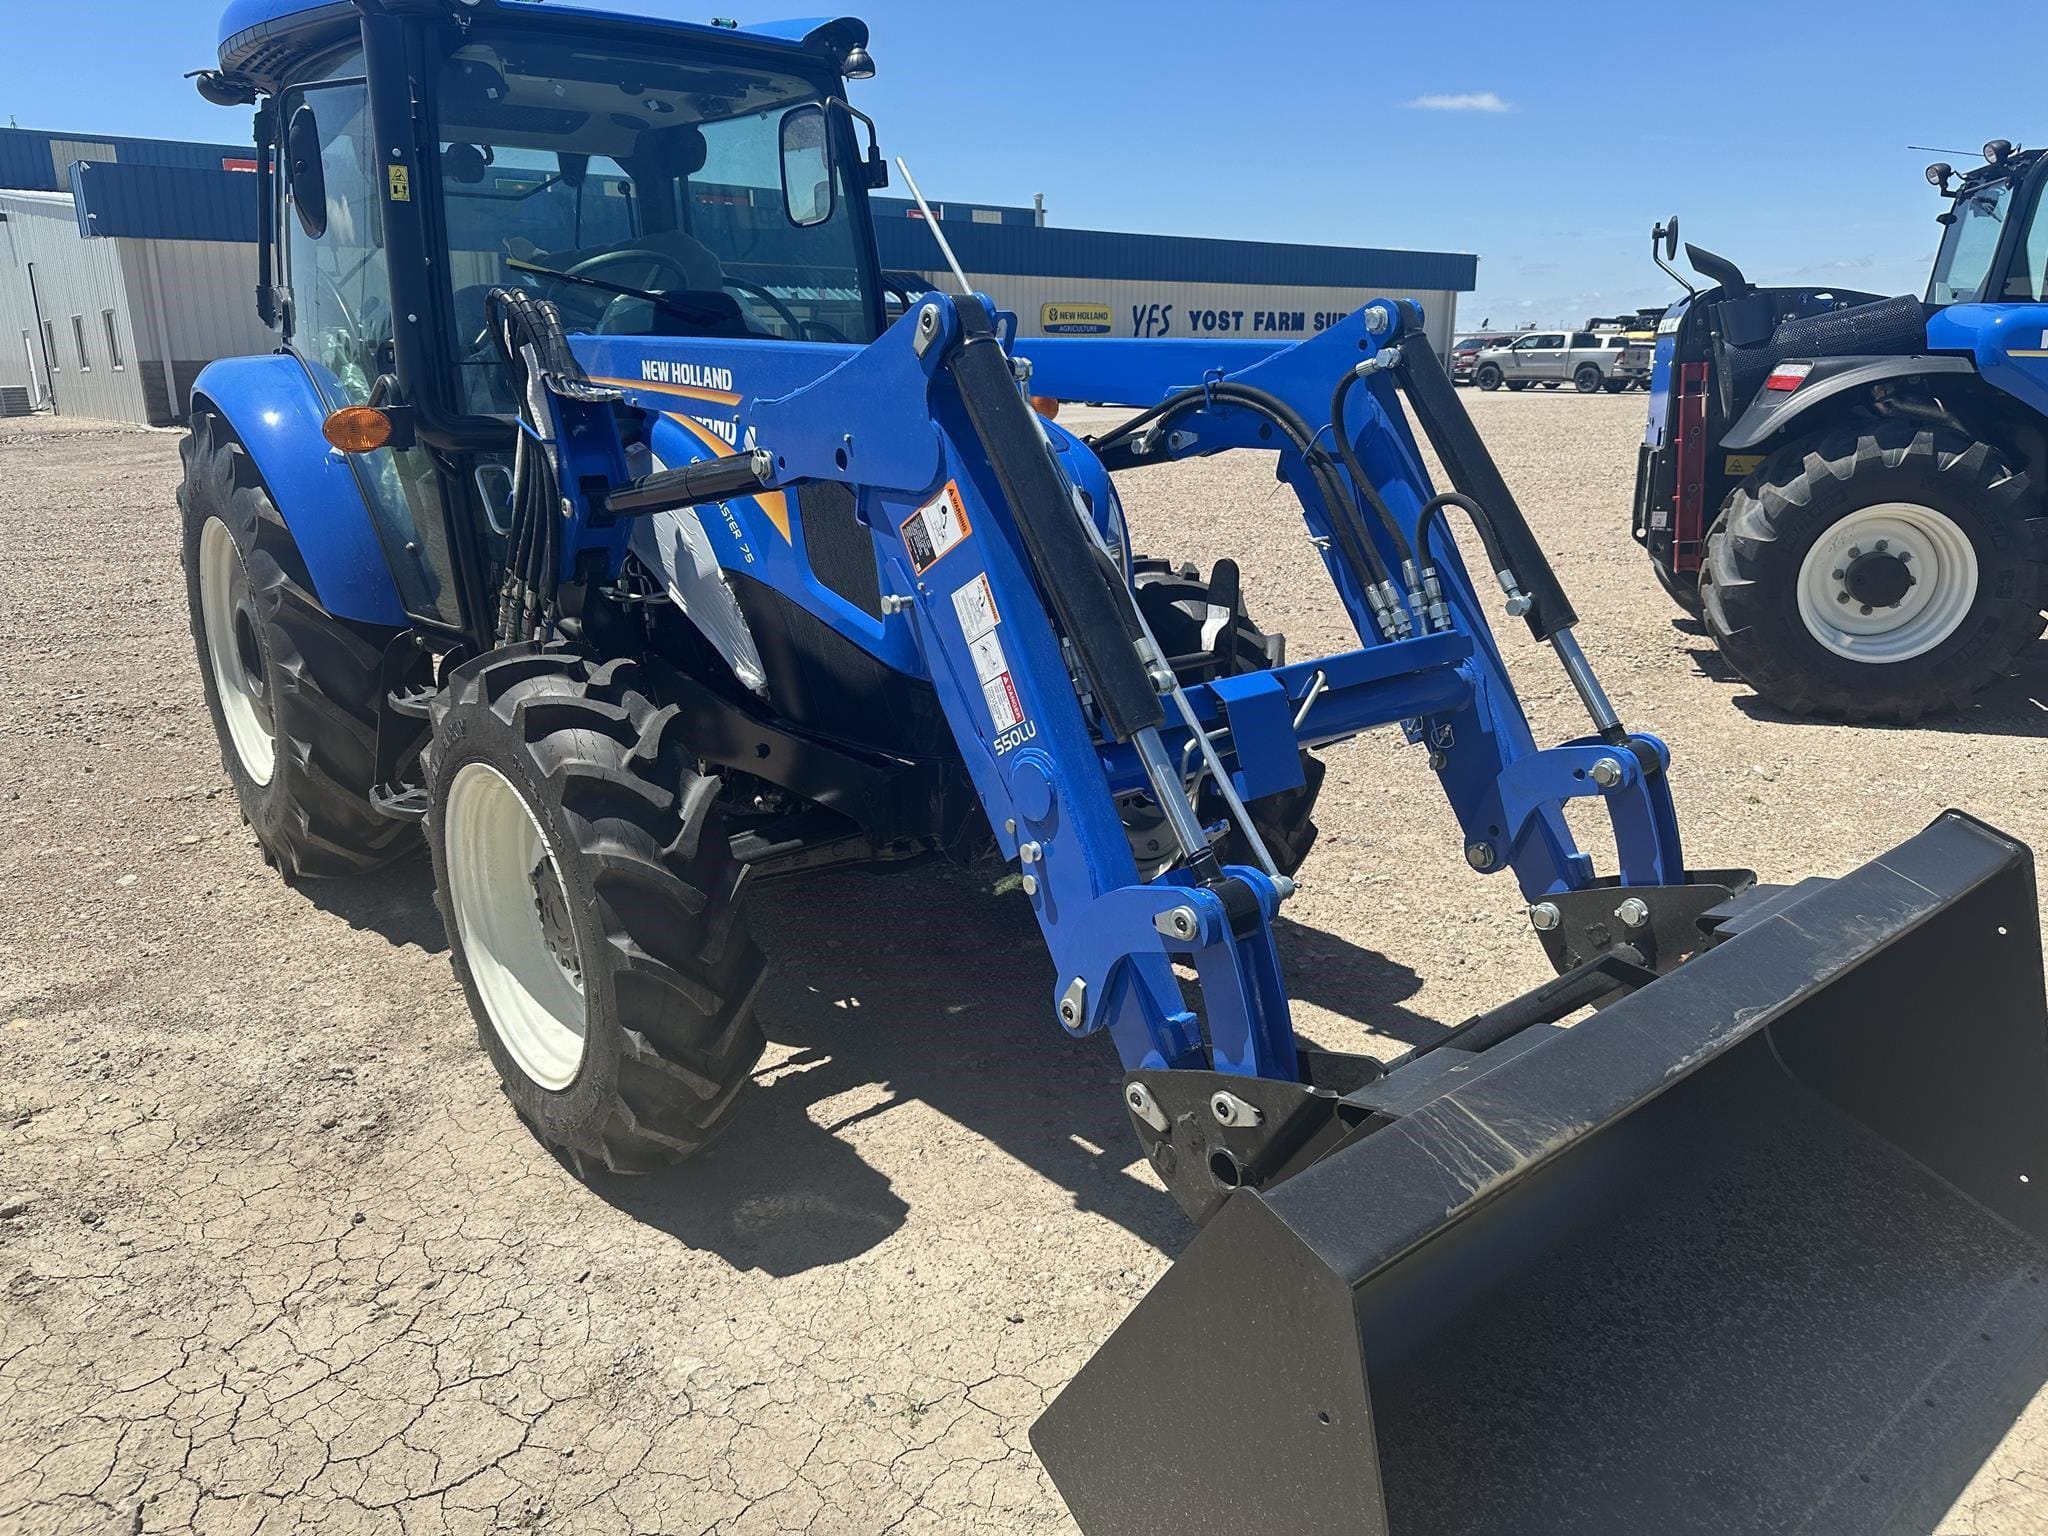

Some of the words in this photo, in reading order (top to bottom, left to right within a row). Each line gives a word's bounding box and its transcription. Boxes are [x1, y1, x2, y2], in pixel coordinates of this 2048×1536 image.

[1058, 325, 1097, 333] AGRICULTURE
[1060, 311, 1076, 320] NEW
[1077, 311, 1108, 321] HOLLAND
[1132, 304, 1173, 338] YFS
[1188, 310, 1244, 331] YOST
[1253, 311, 1305, 331] FARM
[641, 360, 669, 382] NEW
[671, 362, 733, 391] HOLLAND
[717, 501, 742, 539] ASTER
[740, 543, 755, 563] 75
[953, 498, 968, 532] WARNING
[1006, 685, 1022, 720] DANGER
[993, 720, 1037, 756] 550LU
